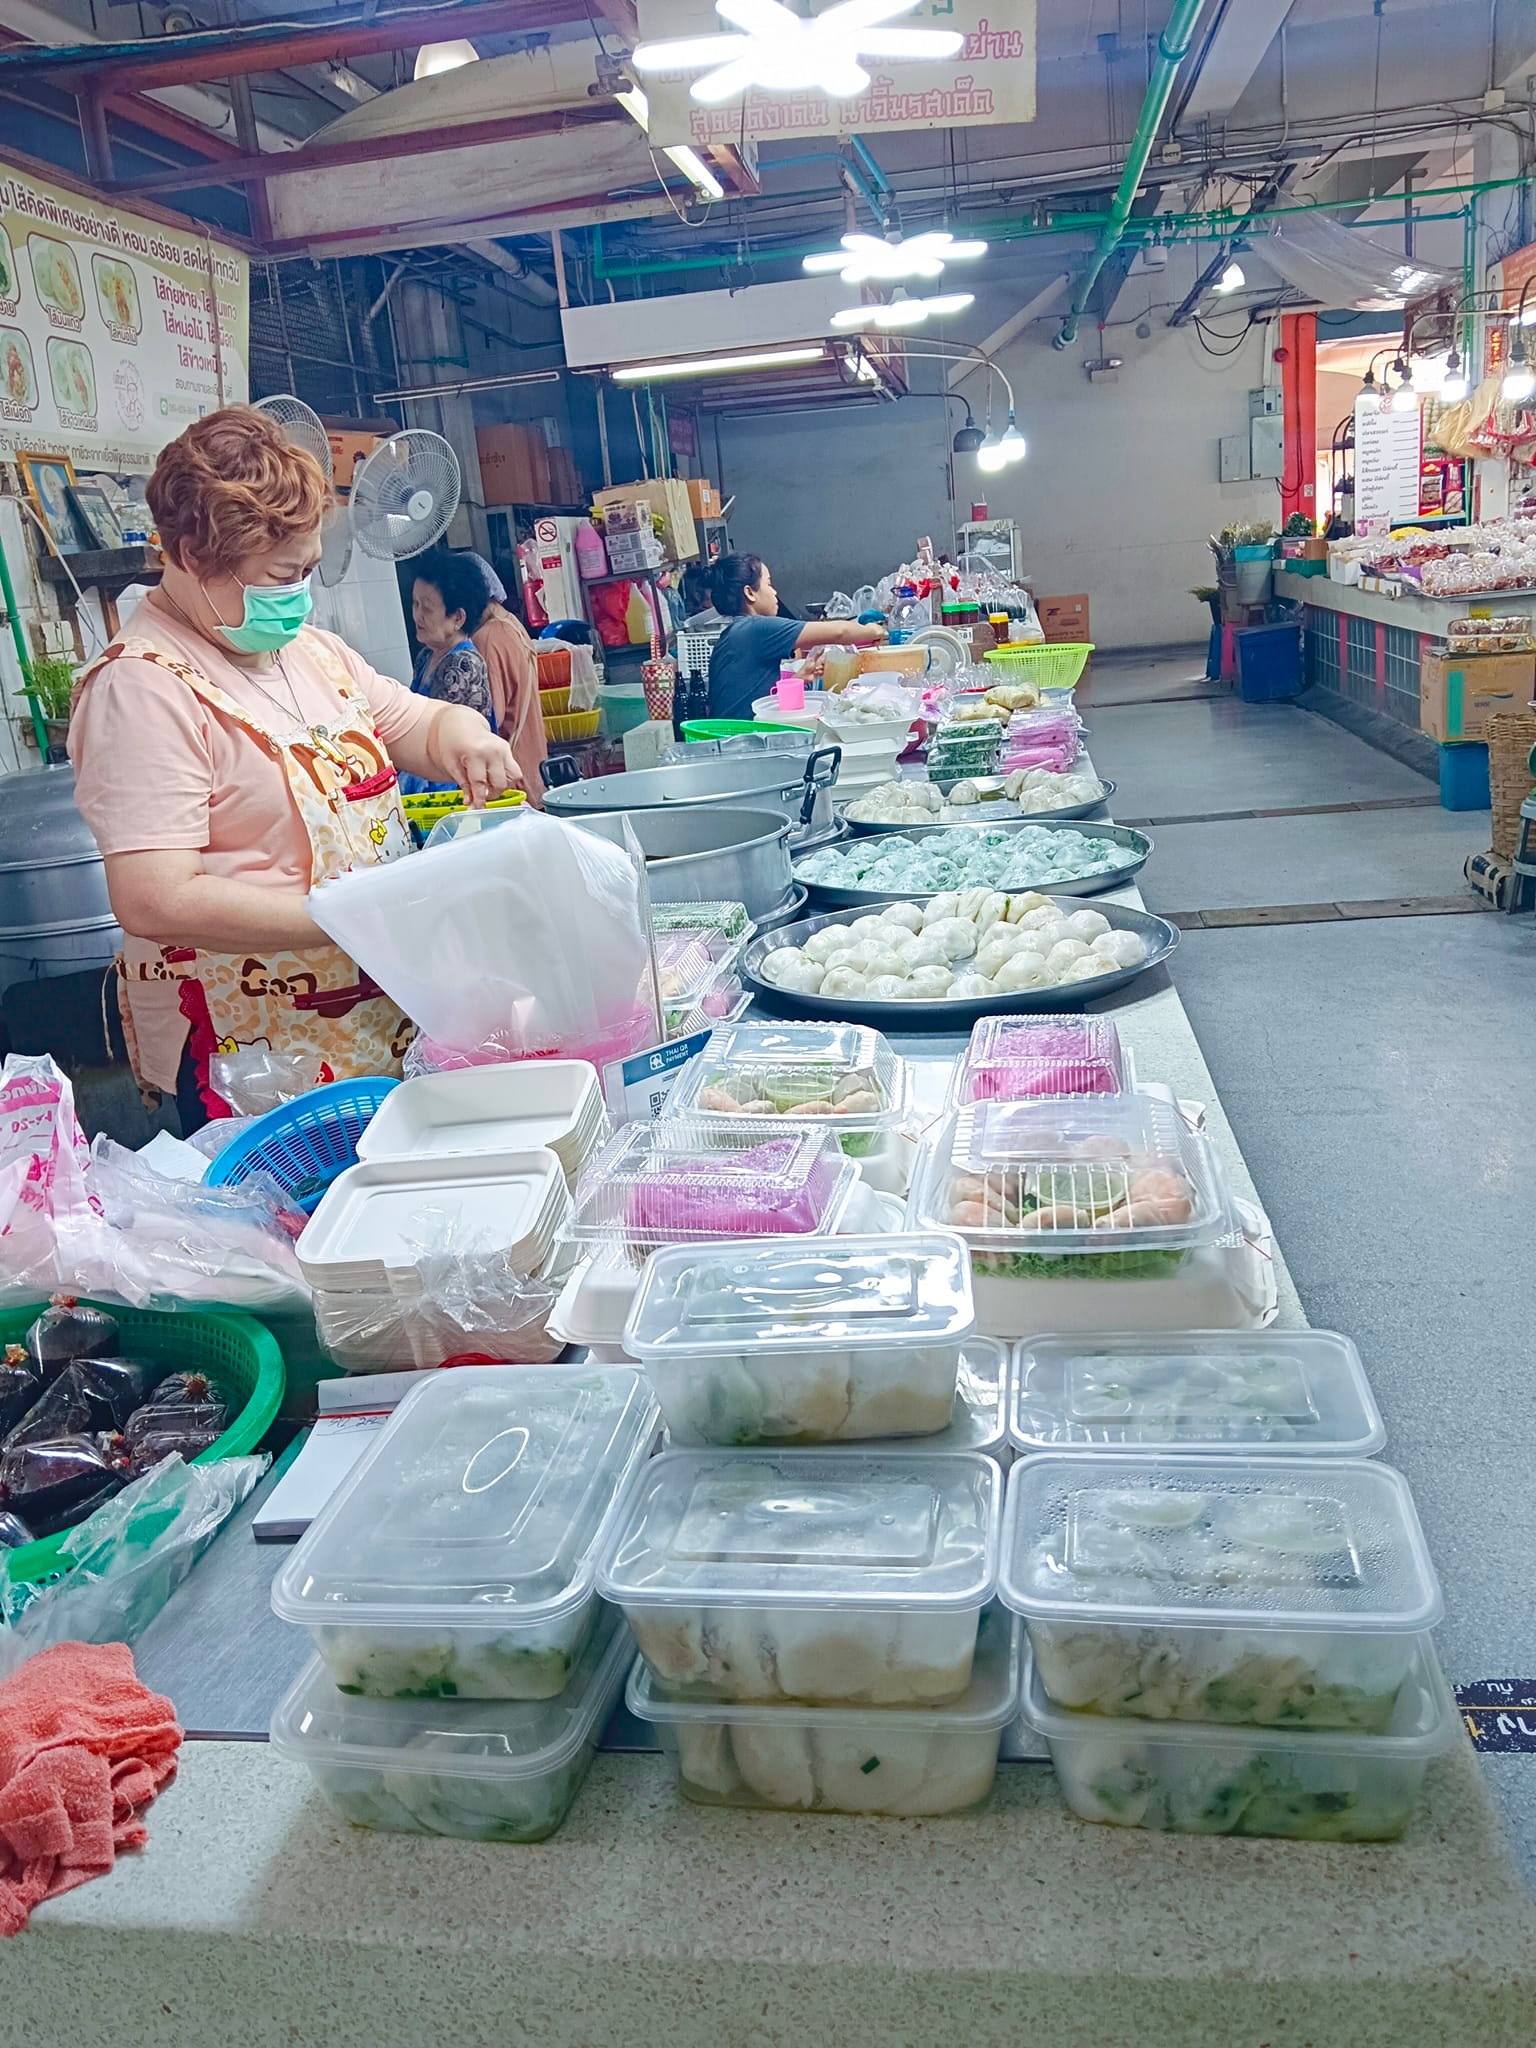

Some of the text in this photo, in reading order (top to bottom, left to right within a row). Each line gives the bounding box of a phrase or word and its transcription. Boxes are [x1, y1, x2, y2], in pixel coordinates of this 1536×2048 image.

[838, 75, 995, 125] นำจิ้มรสเด็ด
[122, 230, 148, 254] หอม
[149, 235, 181, 264] อร่อย
